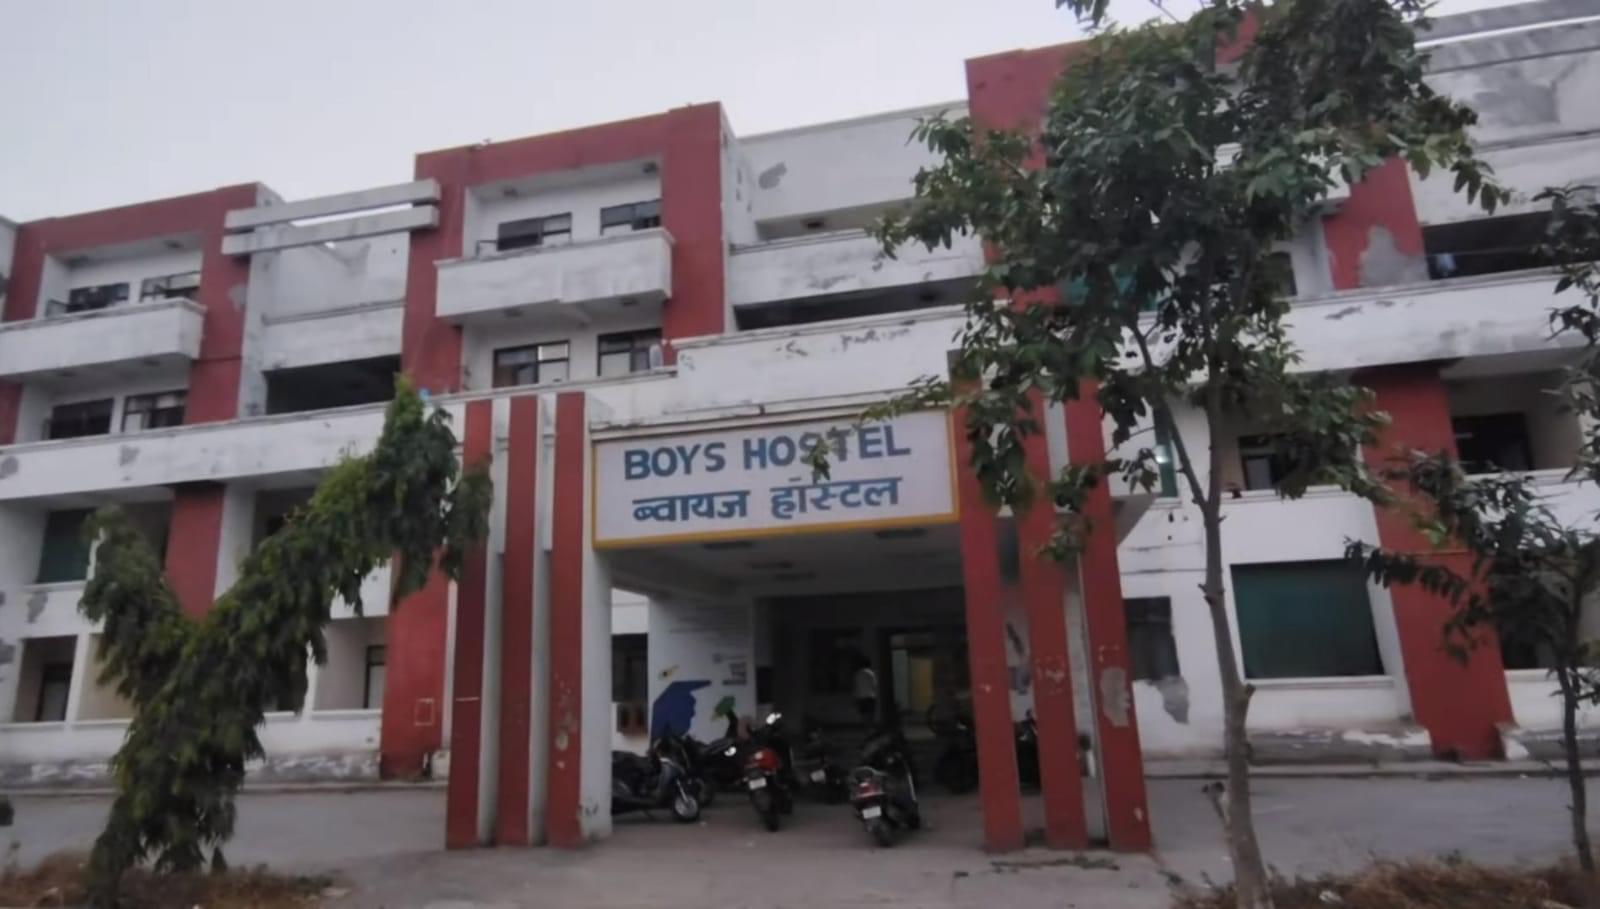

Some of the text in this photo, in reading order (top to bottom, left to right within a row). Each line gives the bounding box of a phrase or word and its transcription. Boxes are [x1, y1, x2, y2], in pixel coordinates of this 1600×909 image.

[624, 425, 912, 480] BOYS HOSTEL
[632, 490, 751, 521] ब्वायज
